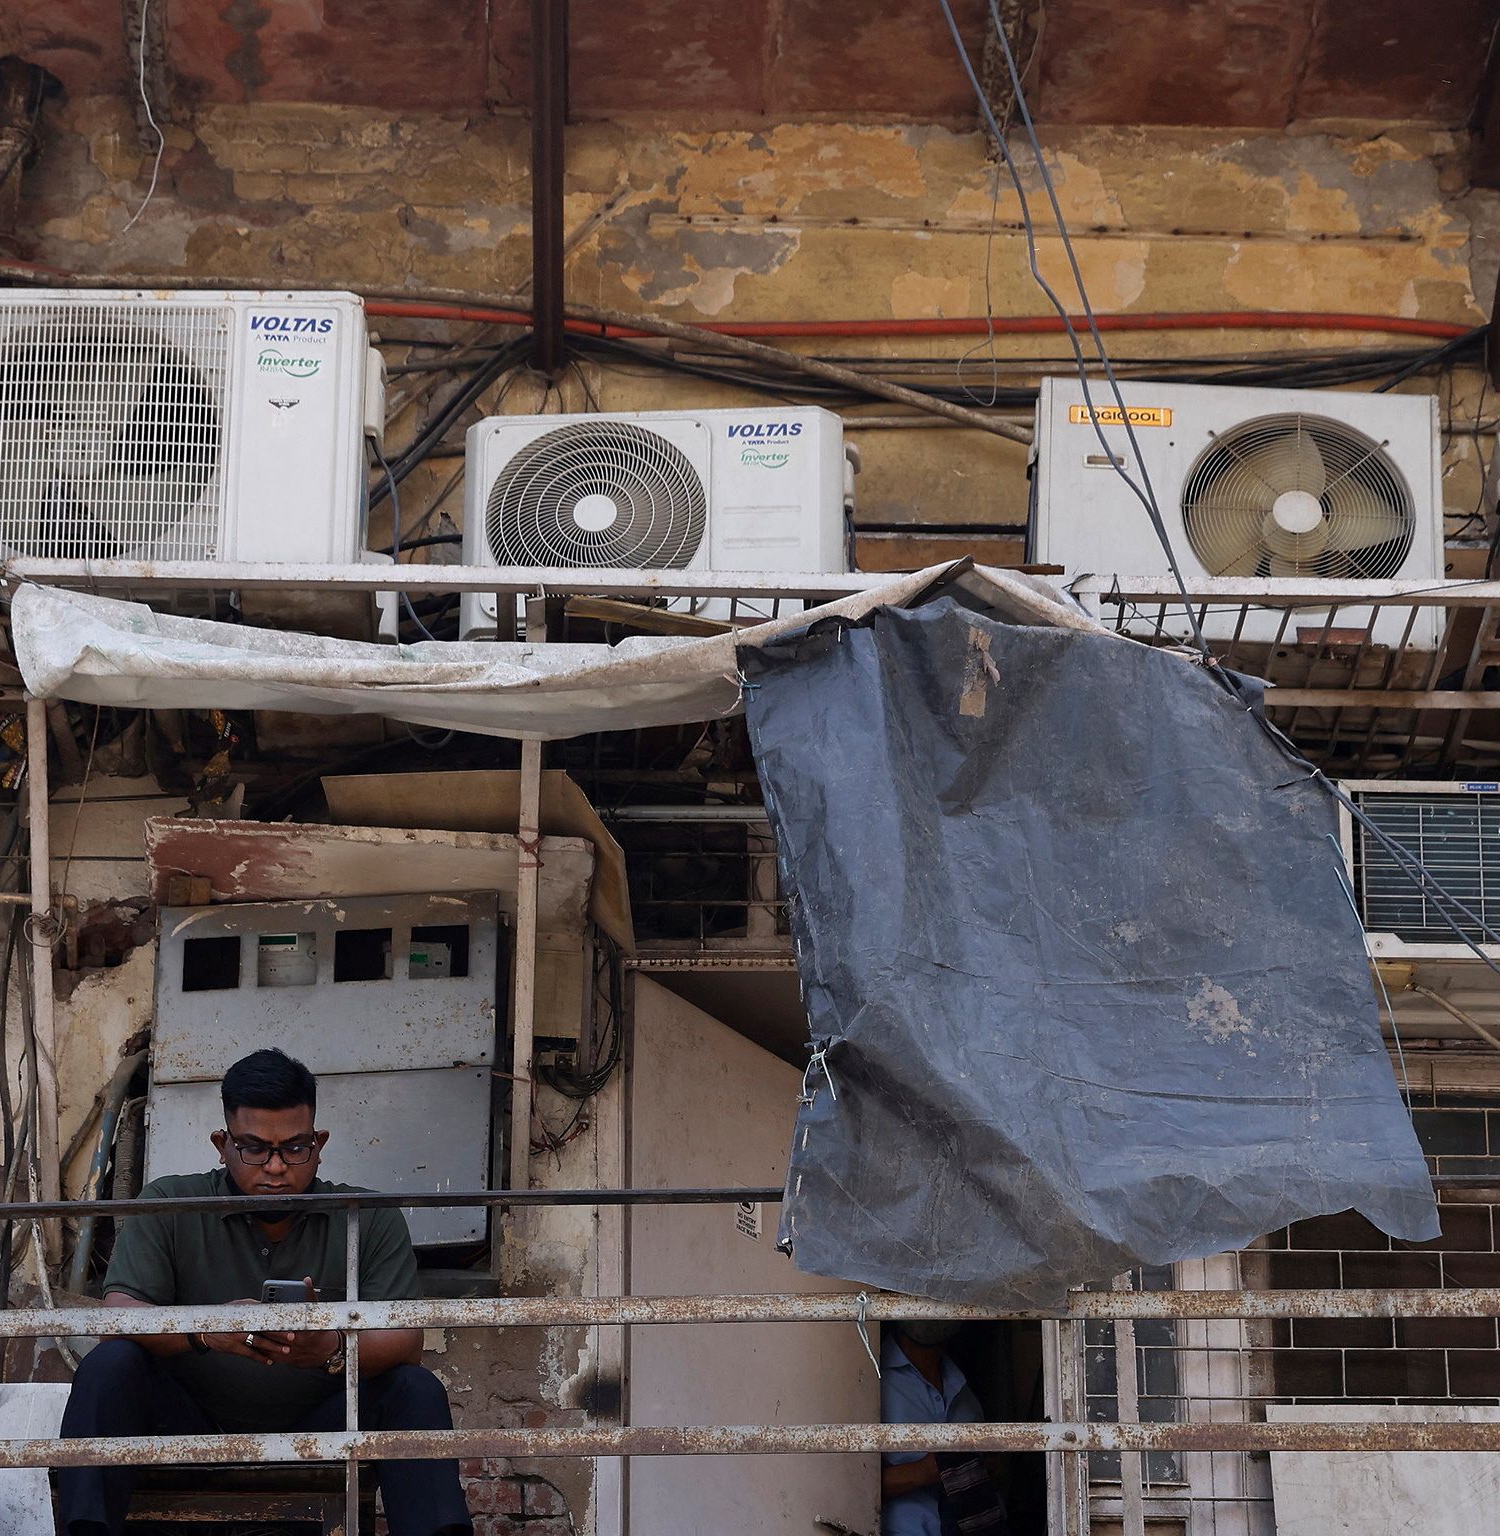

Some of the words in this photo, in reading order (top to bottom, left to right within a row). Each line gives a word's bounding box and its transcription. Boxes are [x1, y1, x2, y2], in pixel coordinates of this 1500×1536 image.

[250, 315, 334, 334] VOLTAS
[264, 334, 290, 342] TATA
[293, 335, 327, 344] Product
[257, 354, 322, 368] Inverter
[728, 422, 803, 438] VOLTAS
[740, 453, 790, 463] Inverter
